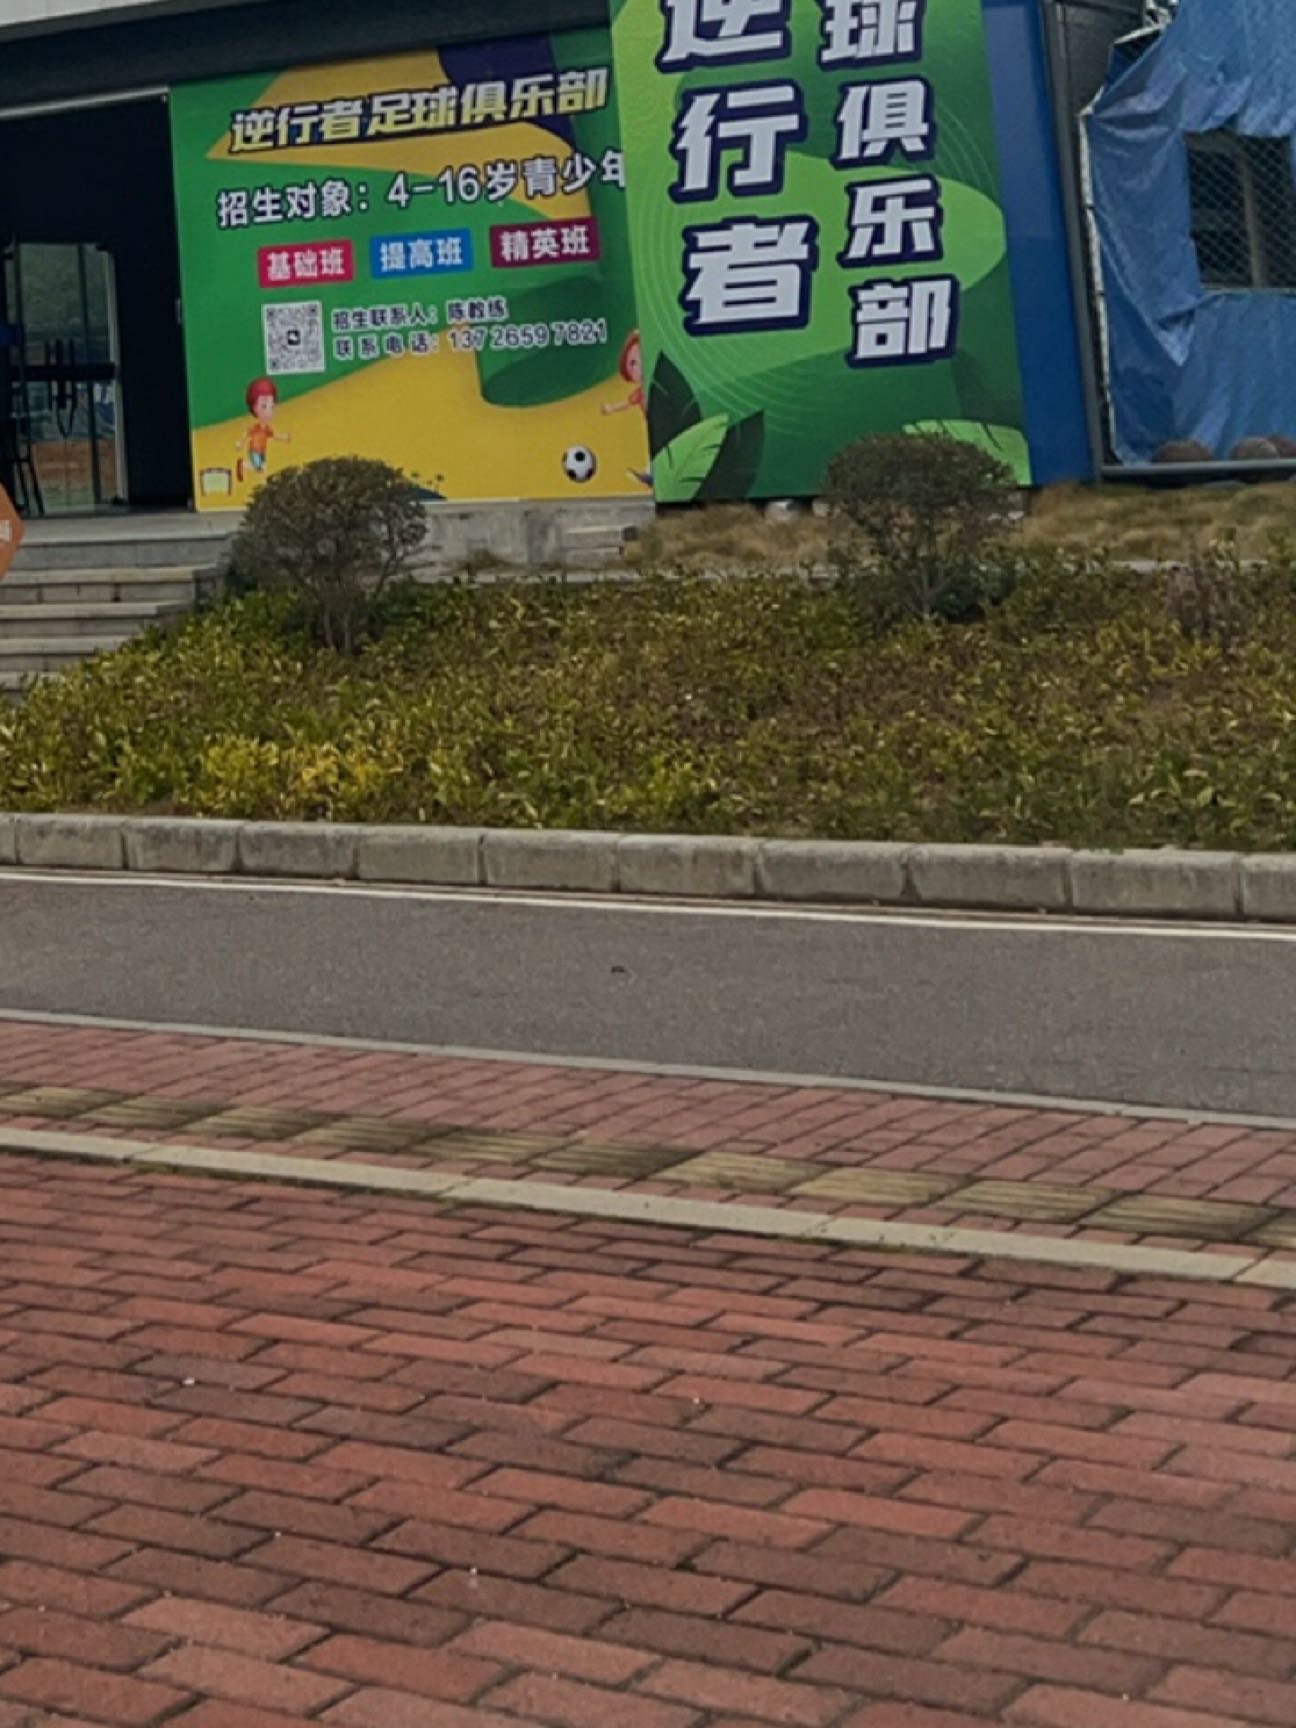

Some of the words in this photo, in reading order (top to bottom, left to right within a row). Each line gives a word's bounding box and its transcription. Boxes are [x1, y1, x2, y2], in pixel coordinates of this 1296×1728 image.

[230, 68, 609, 152] 逆行者足球俱乐部
[380, 236, 463, 270] 提高班
[501, 224, 590, 262] 精英班
[267, 246, 345, 280] 基础班
